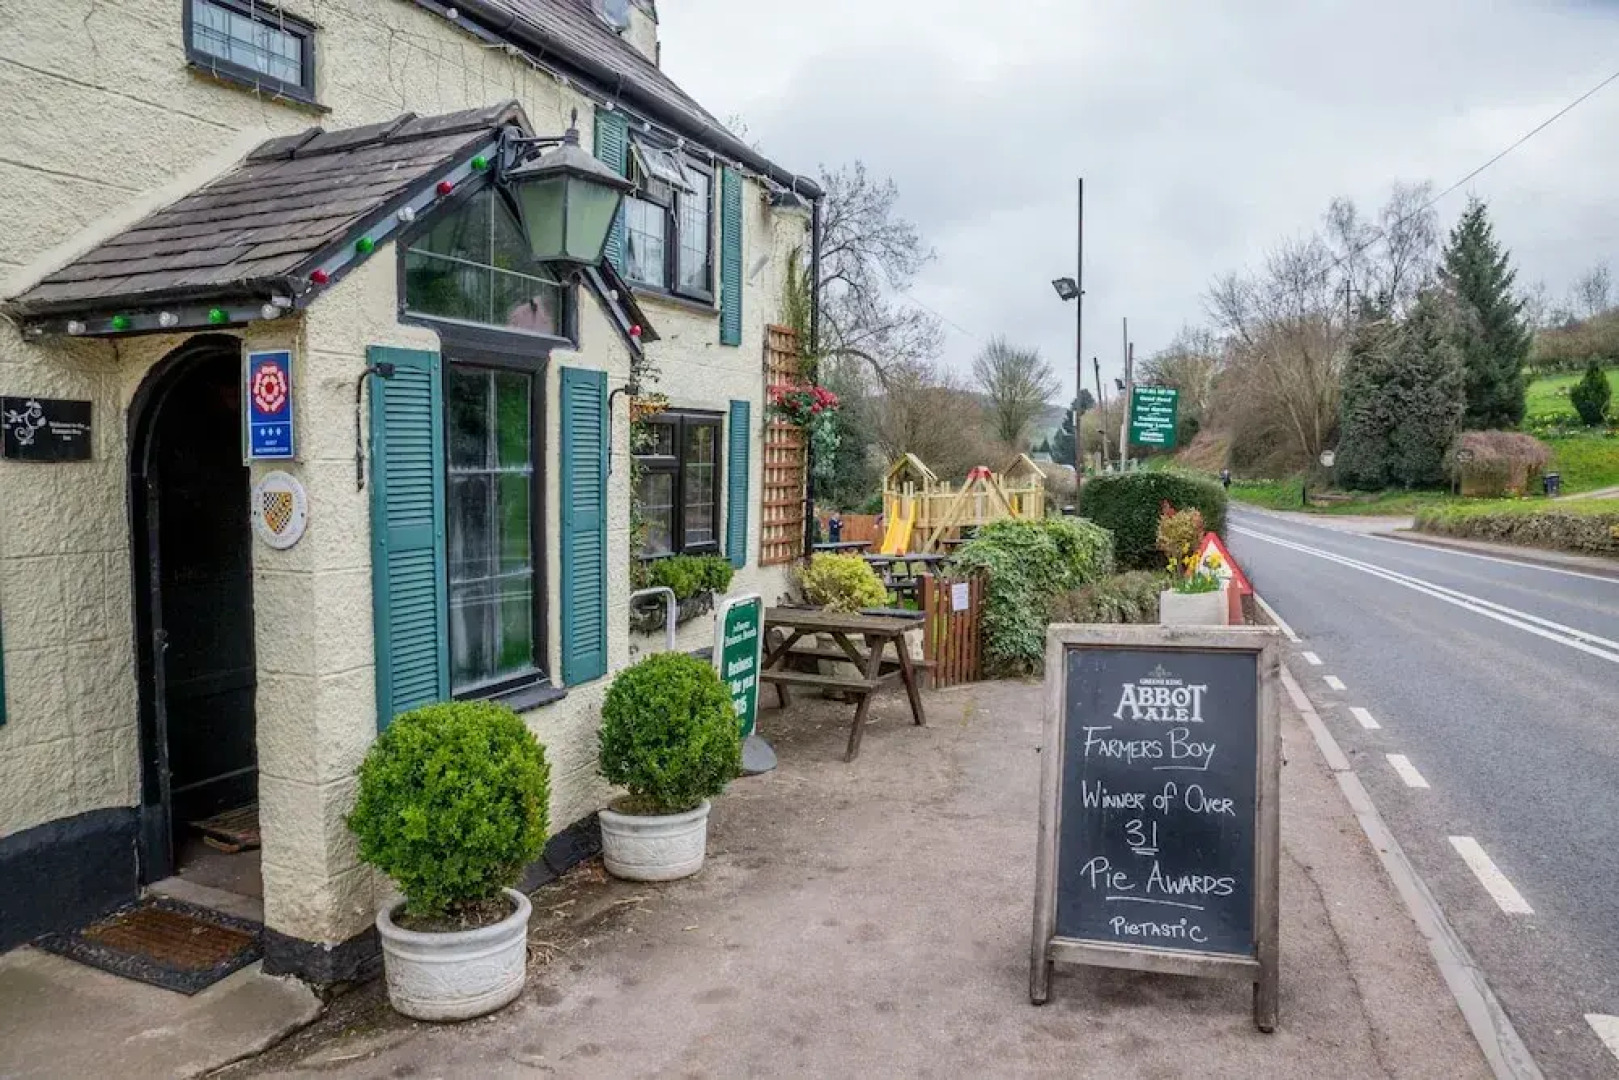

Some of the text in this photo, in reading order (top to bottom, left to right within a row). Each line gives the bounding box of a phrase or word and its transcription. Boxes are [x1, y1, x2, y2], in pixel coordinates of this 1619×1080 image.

[1113, 683, 1208, 722] ABBOT
[1143, 706, 1190, 722] ALE
[1124, 818, 1157, 848] 31
